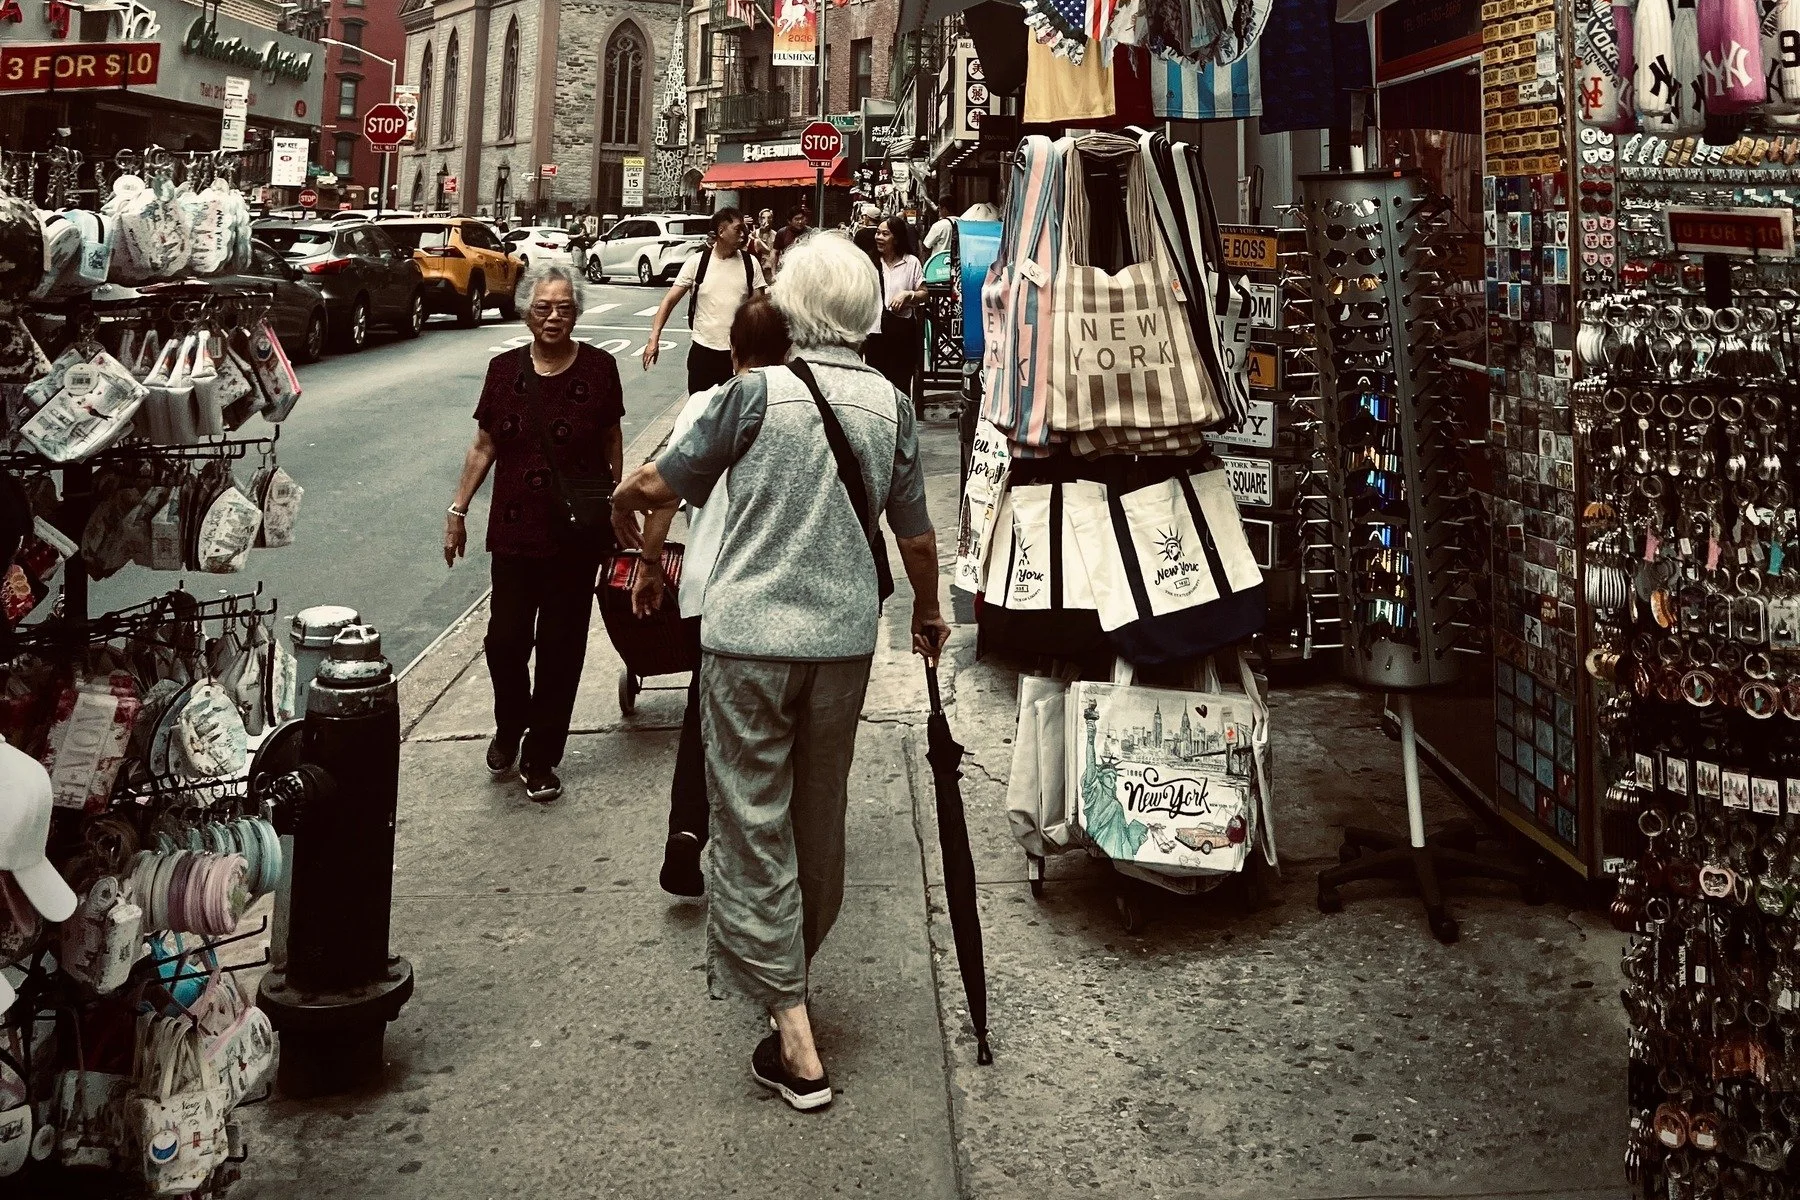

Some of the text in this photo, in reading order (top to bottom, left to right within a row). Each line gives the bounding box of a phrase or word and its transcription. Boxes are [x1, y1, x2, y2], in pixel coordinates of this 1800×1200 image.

[788, 34, 813, 42] 2026
[774, 53, 815, 61] FLUSHING
[6, 57, 24, 81] 3
[33, 54, 96, 80] FOR
[367, 117, 405, 134] STOP
[803, 134, 839, 151] STOP
[628, 179, 639, 188] 15
[300, 195, 317, 203] STOP
[1219, 227, 1238, 235] NEW
[1700, 222, 1737, 241] FOR
[1233, 238, 1266, 260] BOSS
[1080, 311, 1158, 343] NEW
[1072, 340, 1173, 374] YORK
[1230, 461, 1249, 469] YORK
[1233, 470, 1267, 495] SQUARE
[1018, 568, 1044, 583] York
[1155, 561, 1199, 586] New York
[1124, 777, 1212, 819] New York
[1678, 945, 1687, 988] NEW YORK
